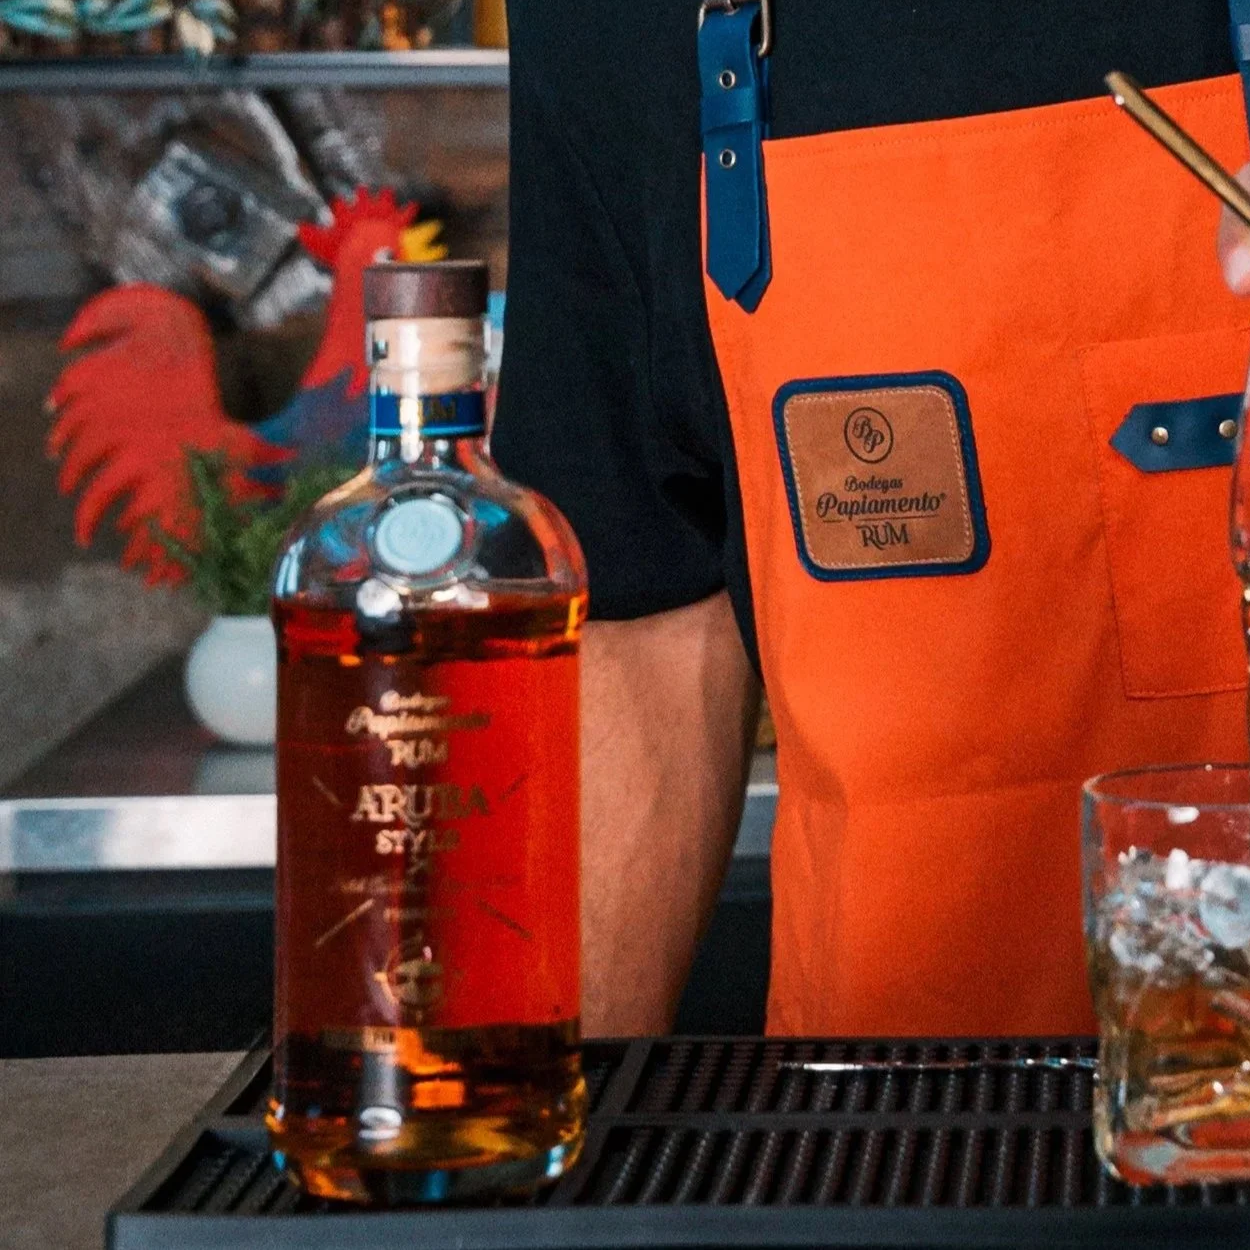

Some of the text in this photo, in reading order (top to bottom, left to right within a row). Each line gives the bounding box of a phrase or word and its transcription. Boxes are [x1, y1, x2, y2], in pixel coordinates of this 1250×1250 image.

[844, 475, 904, 494] Bodegas
[855, 521, 910, 551] RUM
[350, 783, 490, 828] ARUBA
